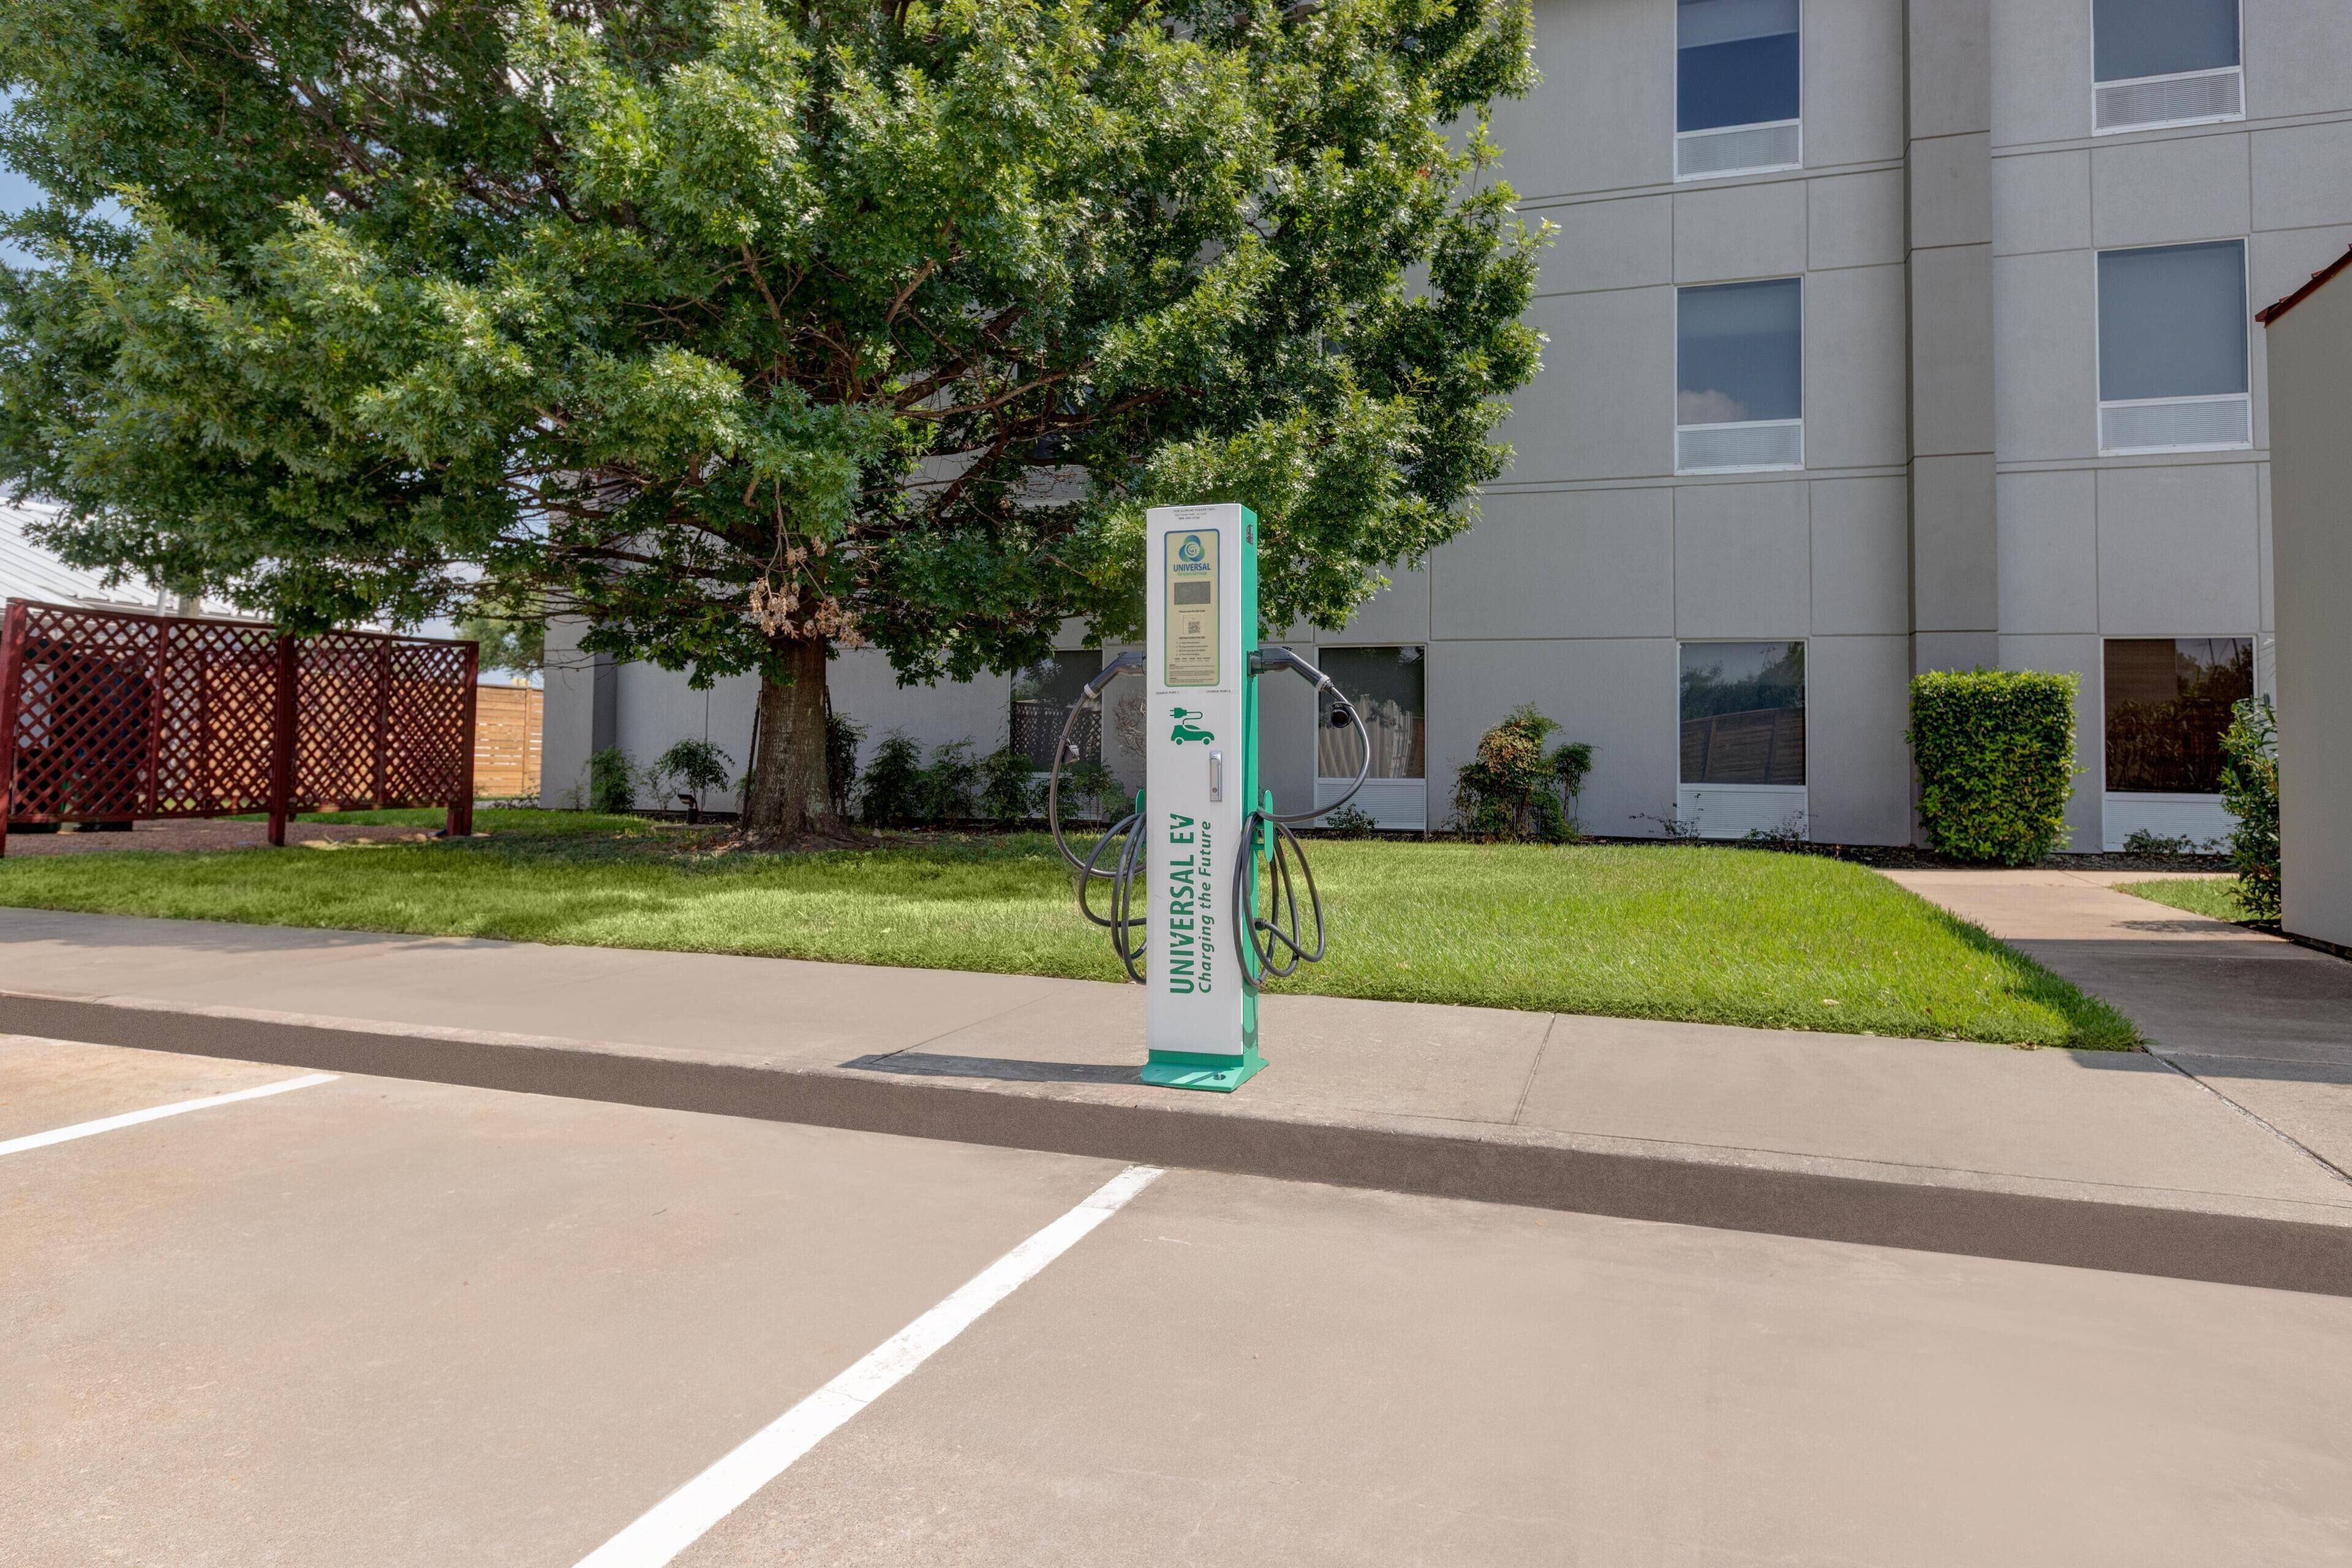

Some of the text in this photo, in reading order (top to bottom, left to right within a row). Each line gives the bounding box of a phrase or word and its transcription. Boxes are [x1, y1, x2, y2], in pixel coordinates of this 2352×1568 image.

[1174, 563, 1211, 571] UNIVERSAL
[1170, 813, 1194, 994] UNIVERSAL EV
[1198, 821, 1215, 993] Charging the Future
